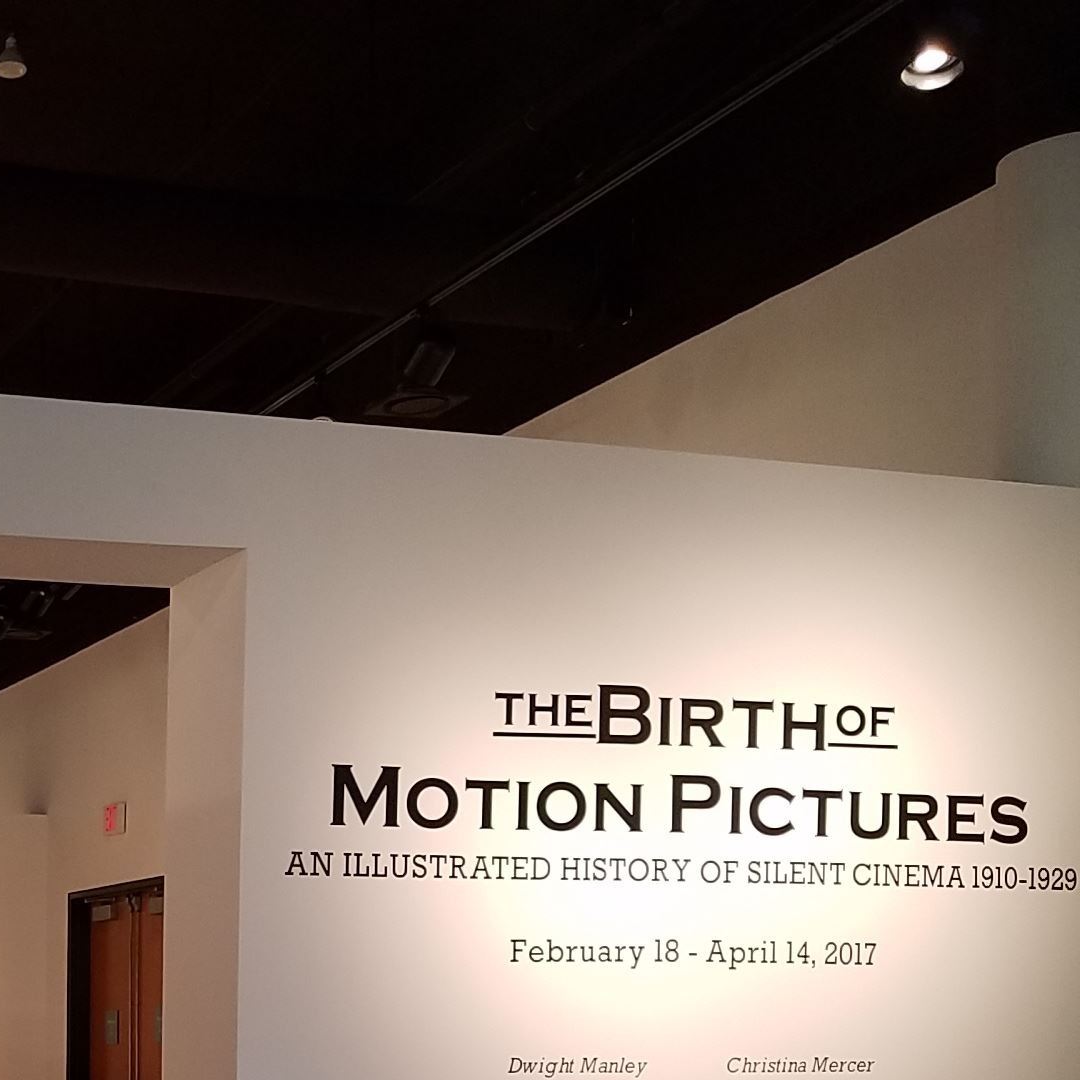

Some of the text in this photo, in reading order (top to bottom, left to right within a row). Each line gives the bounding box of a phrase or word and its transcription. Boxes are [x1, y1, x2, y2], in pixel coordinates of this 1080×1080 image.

[494, 683, 896, 752] THE BIRTH OF
[329, 763, 1029, 846] MOTION PICTURES
[284, 850, 1078, 892] AN ILLUSTRATED HISTORY OF SILENT CINEMA 1910-1929
[509, 938, 646, 970] February
[654, 939, 680, 963] 18
[705, 939, 778, 970] April
[786, 940, 816, 969] 14,
[824, 941, 877, 966] 2017
[507, 1057, 648, 1079] Dwight Manley
[726, 1056, 876, 1074] Christina Mercer
